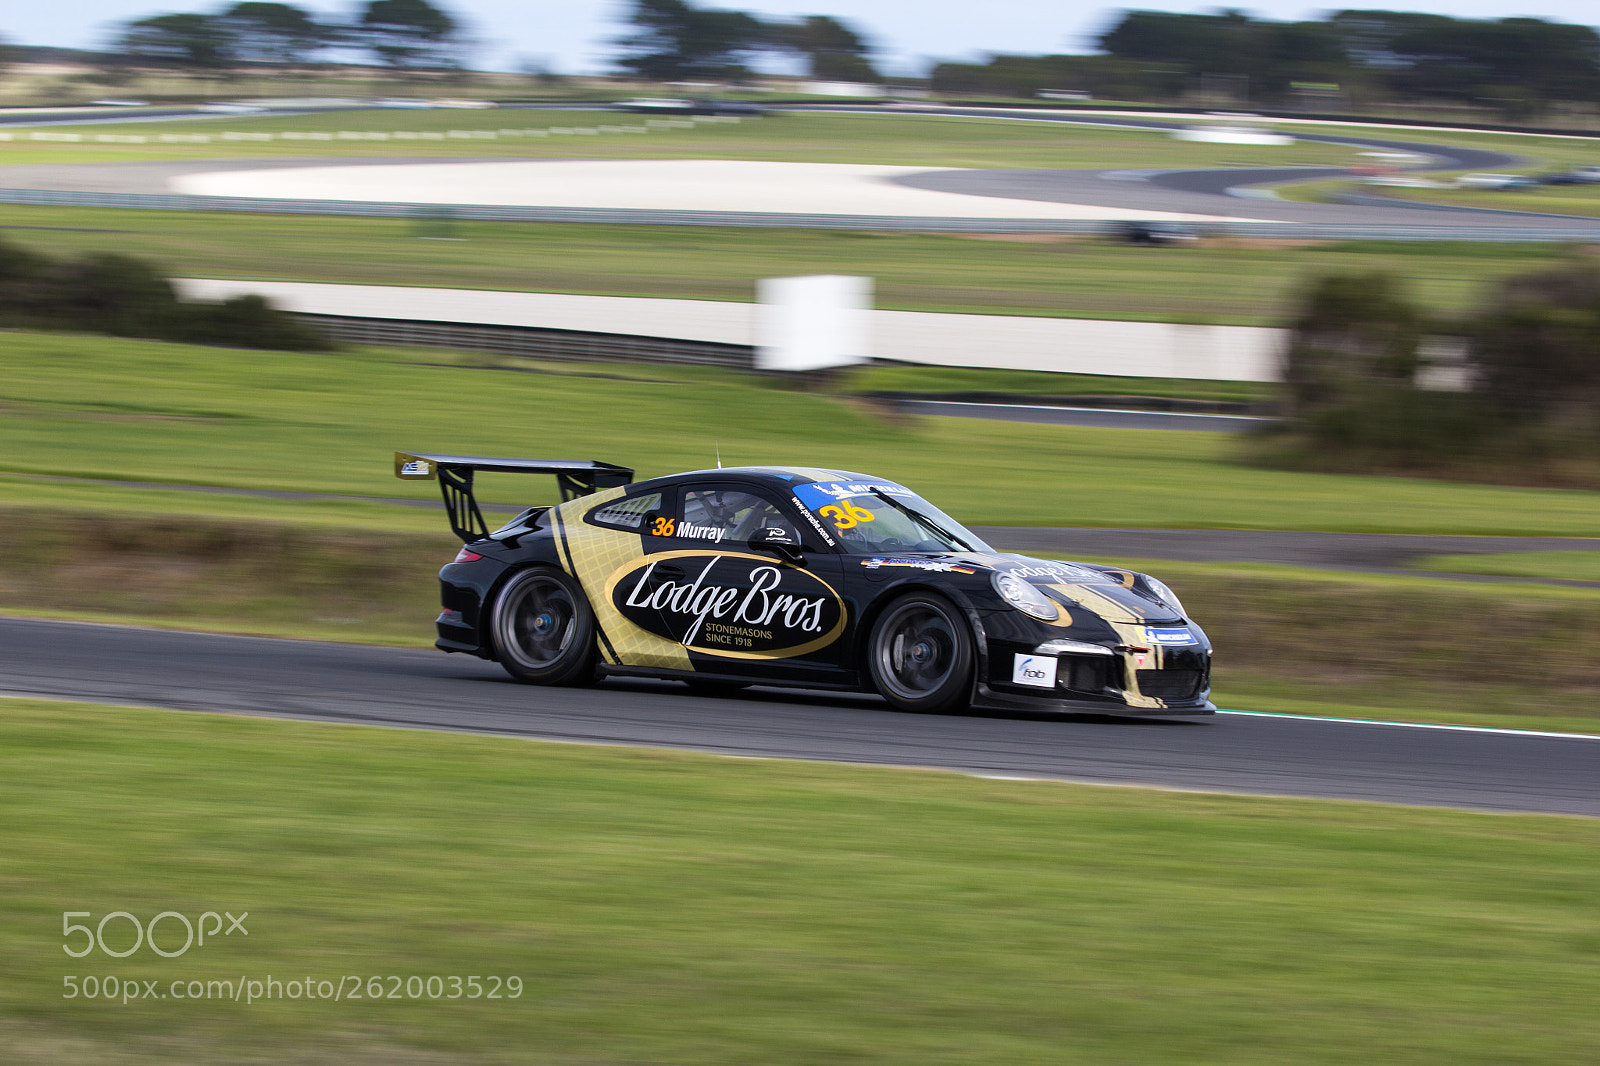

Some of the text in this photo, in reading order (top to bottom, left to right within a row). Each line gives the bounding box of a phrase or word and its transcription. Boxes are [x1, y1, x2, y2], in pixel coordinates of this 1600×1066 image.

[792, 496, 836, 547] www.porsche.com.au
[819, 500, 875, 529] 36
[652, 517, 726, 544] 36 Murray
[626, 555, 826, 645] Lodge Bros.
[705, 633, 752, 647] SINCE 1918
[706, 622, 772, 639] STONEMASONS
